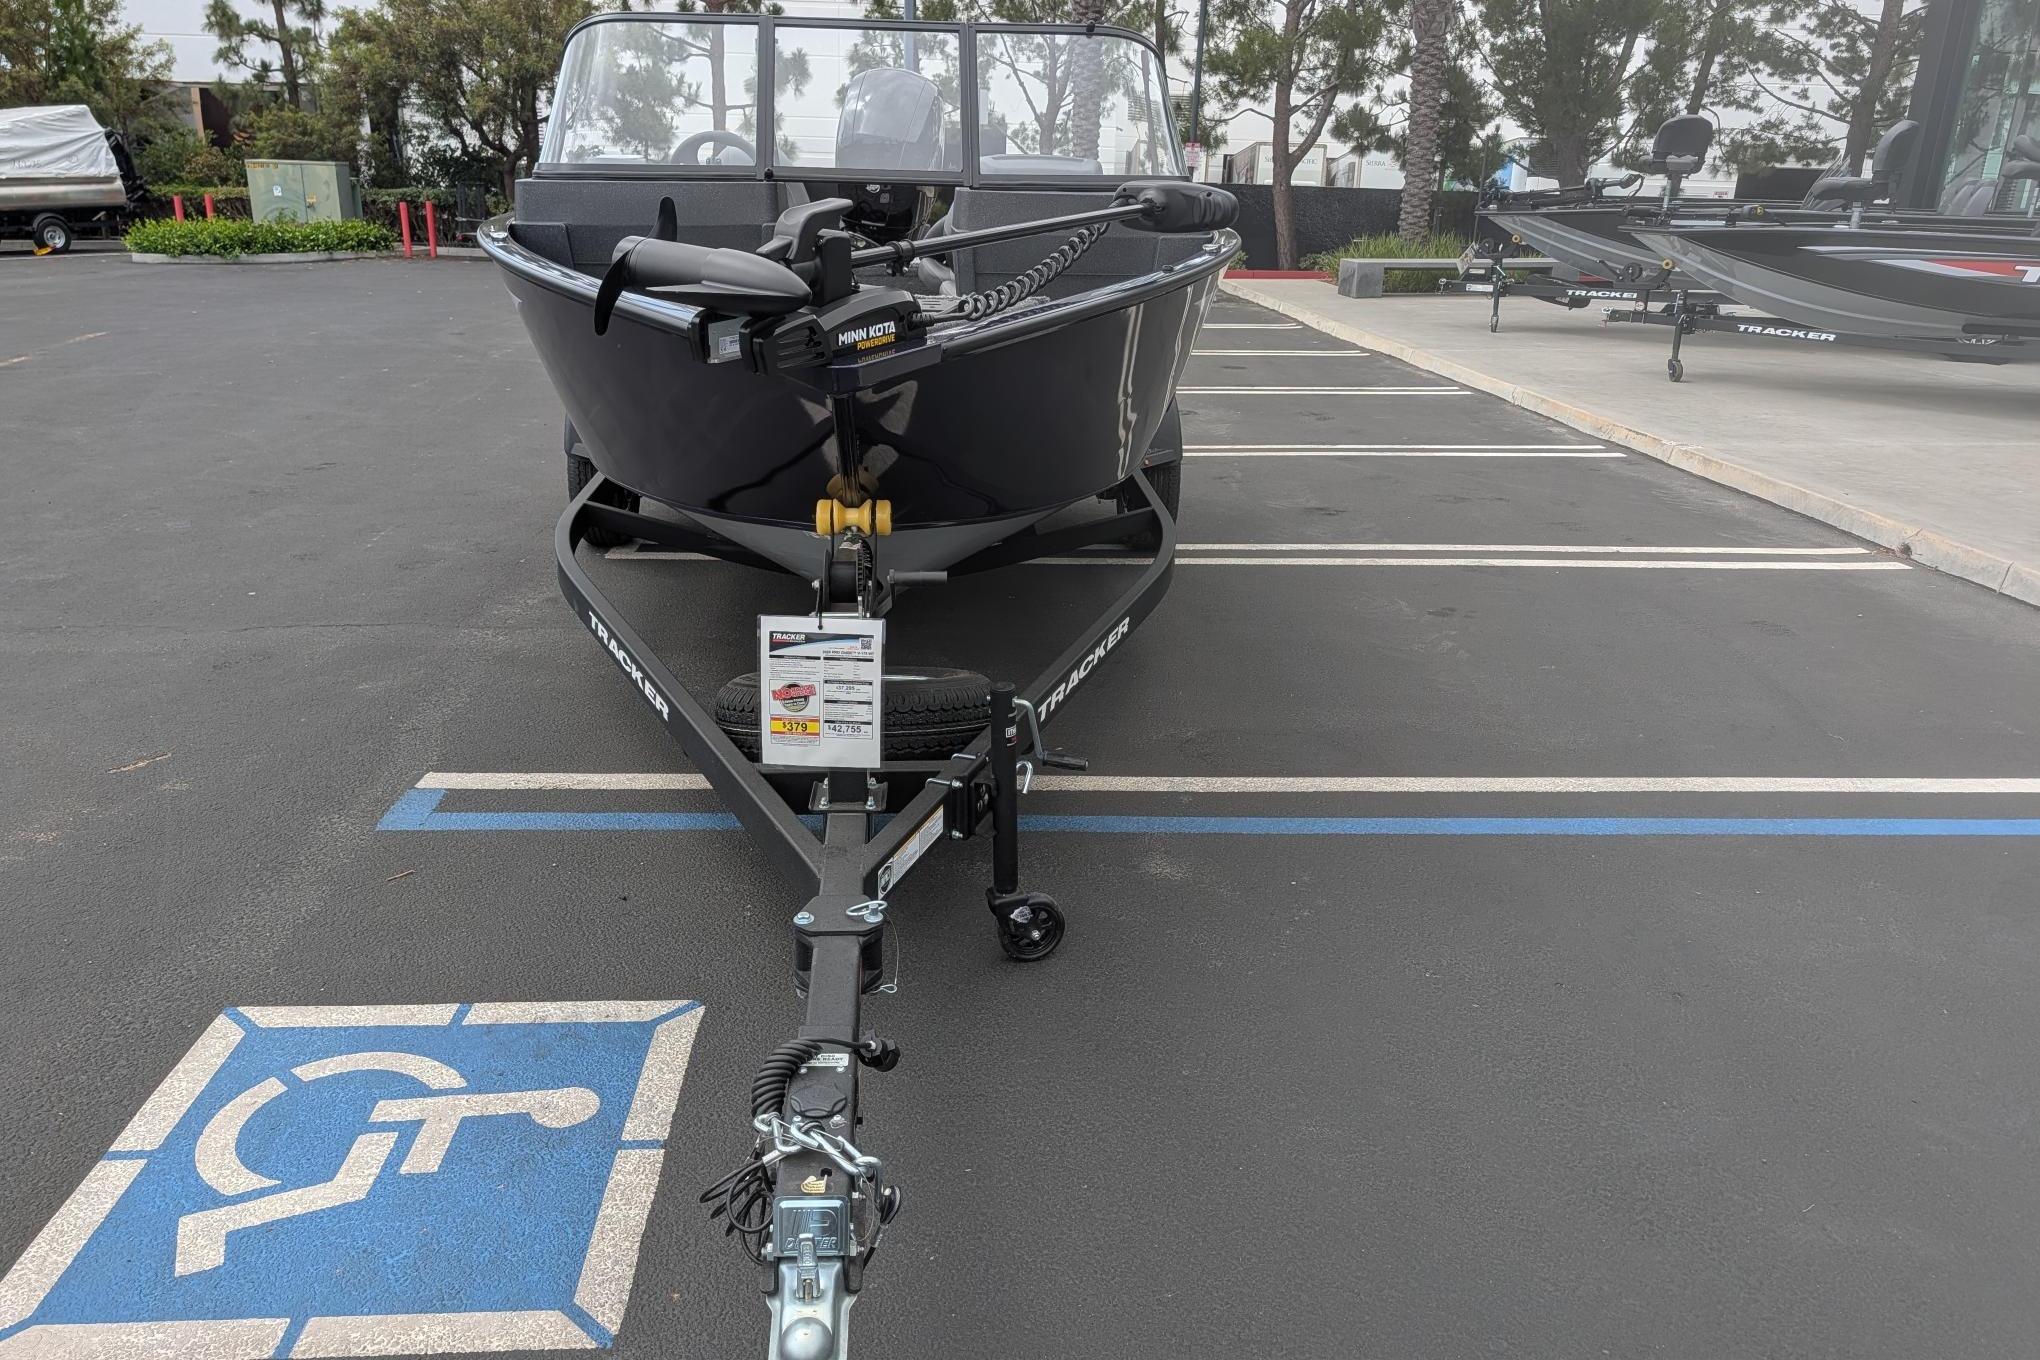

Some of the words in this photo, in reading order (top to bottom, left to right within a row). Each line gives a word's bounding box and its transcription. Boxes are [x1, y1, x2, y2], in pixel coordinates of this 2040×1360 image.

[838, 328, 867, 346] MINN
[869, 320, 896, 338] KOTA
[857, 333, 896, 350] POWERDRIVE
[1736, 324, 1837, 342] TRACKER
[588, 610, 669, 722] TRACKER
[1037, 616, 1130, 722] TRACKER
[782, 721, 808, 732] $379
[828, 724, 862, 734] $42,755
